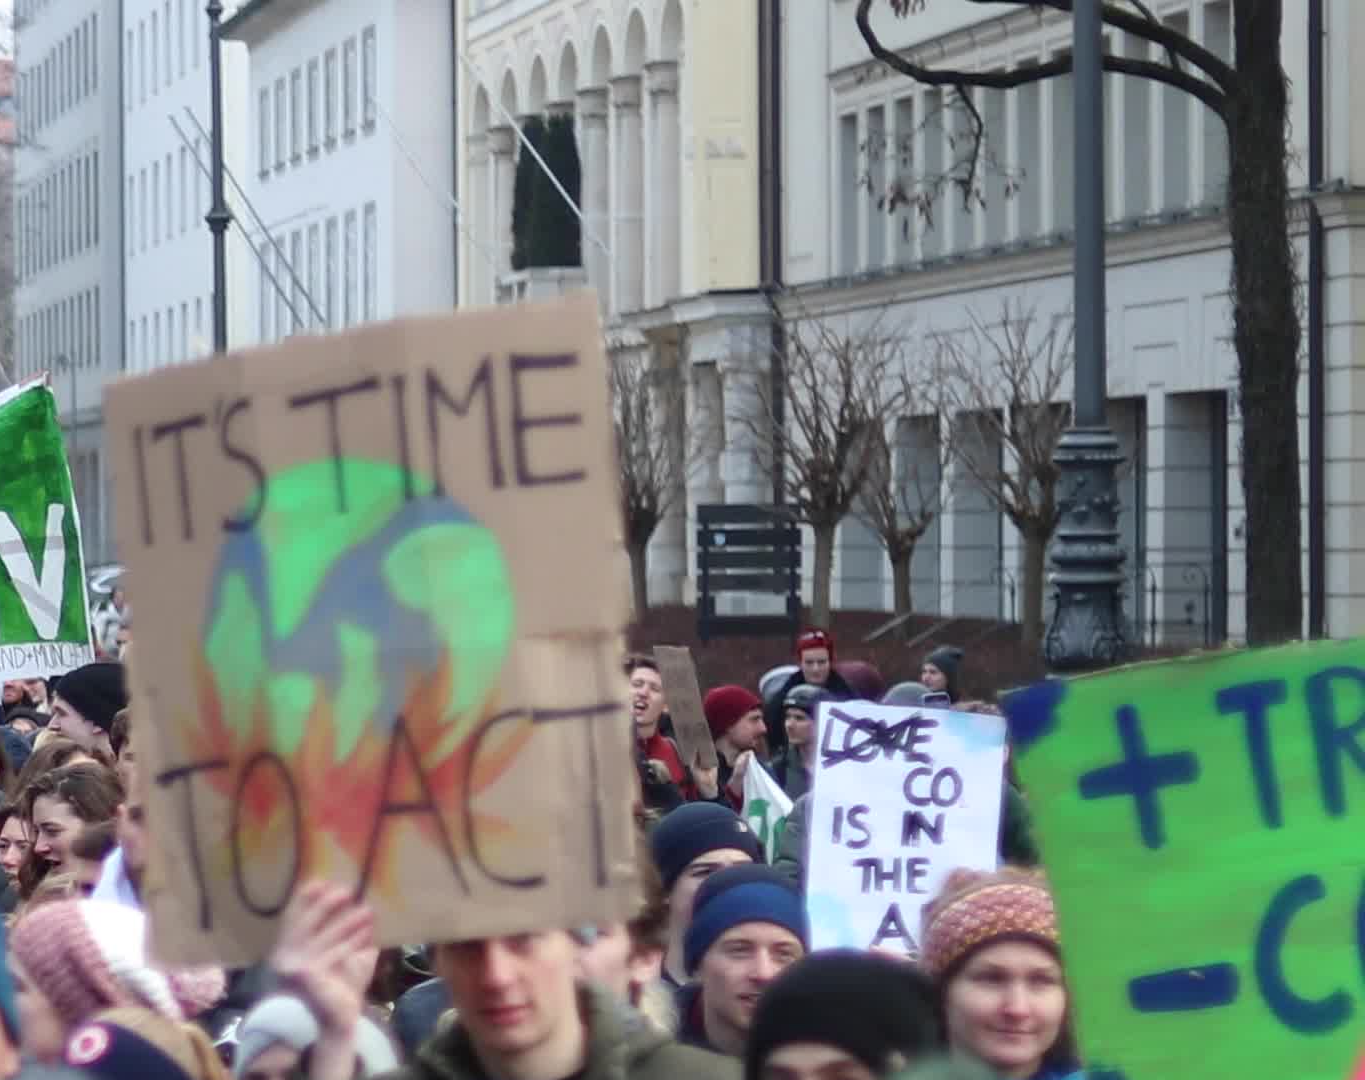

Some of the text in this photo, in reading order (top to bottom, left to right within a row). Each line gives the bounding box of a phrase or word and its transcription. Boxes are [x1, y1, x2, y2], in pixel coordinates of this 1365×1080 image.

[133, 354, 587, 548] IT'S TIME
[903, 766, 964, 808] CO
[155, 702, 624, 931] TO ACT
[831, 805, 946, 850] IS IN
[852, 857, 931, 895] THE
